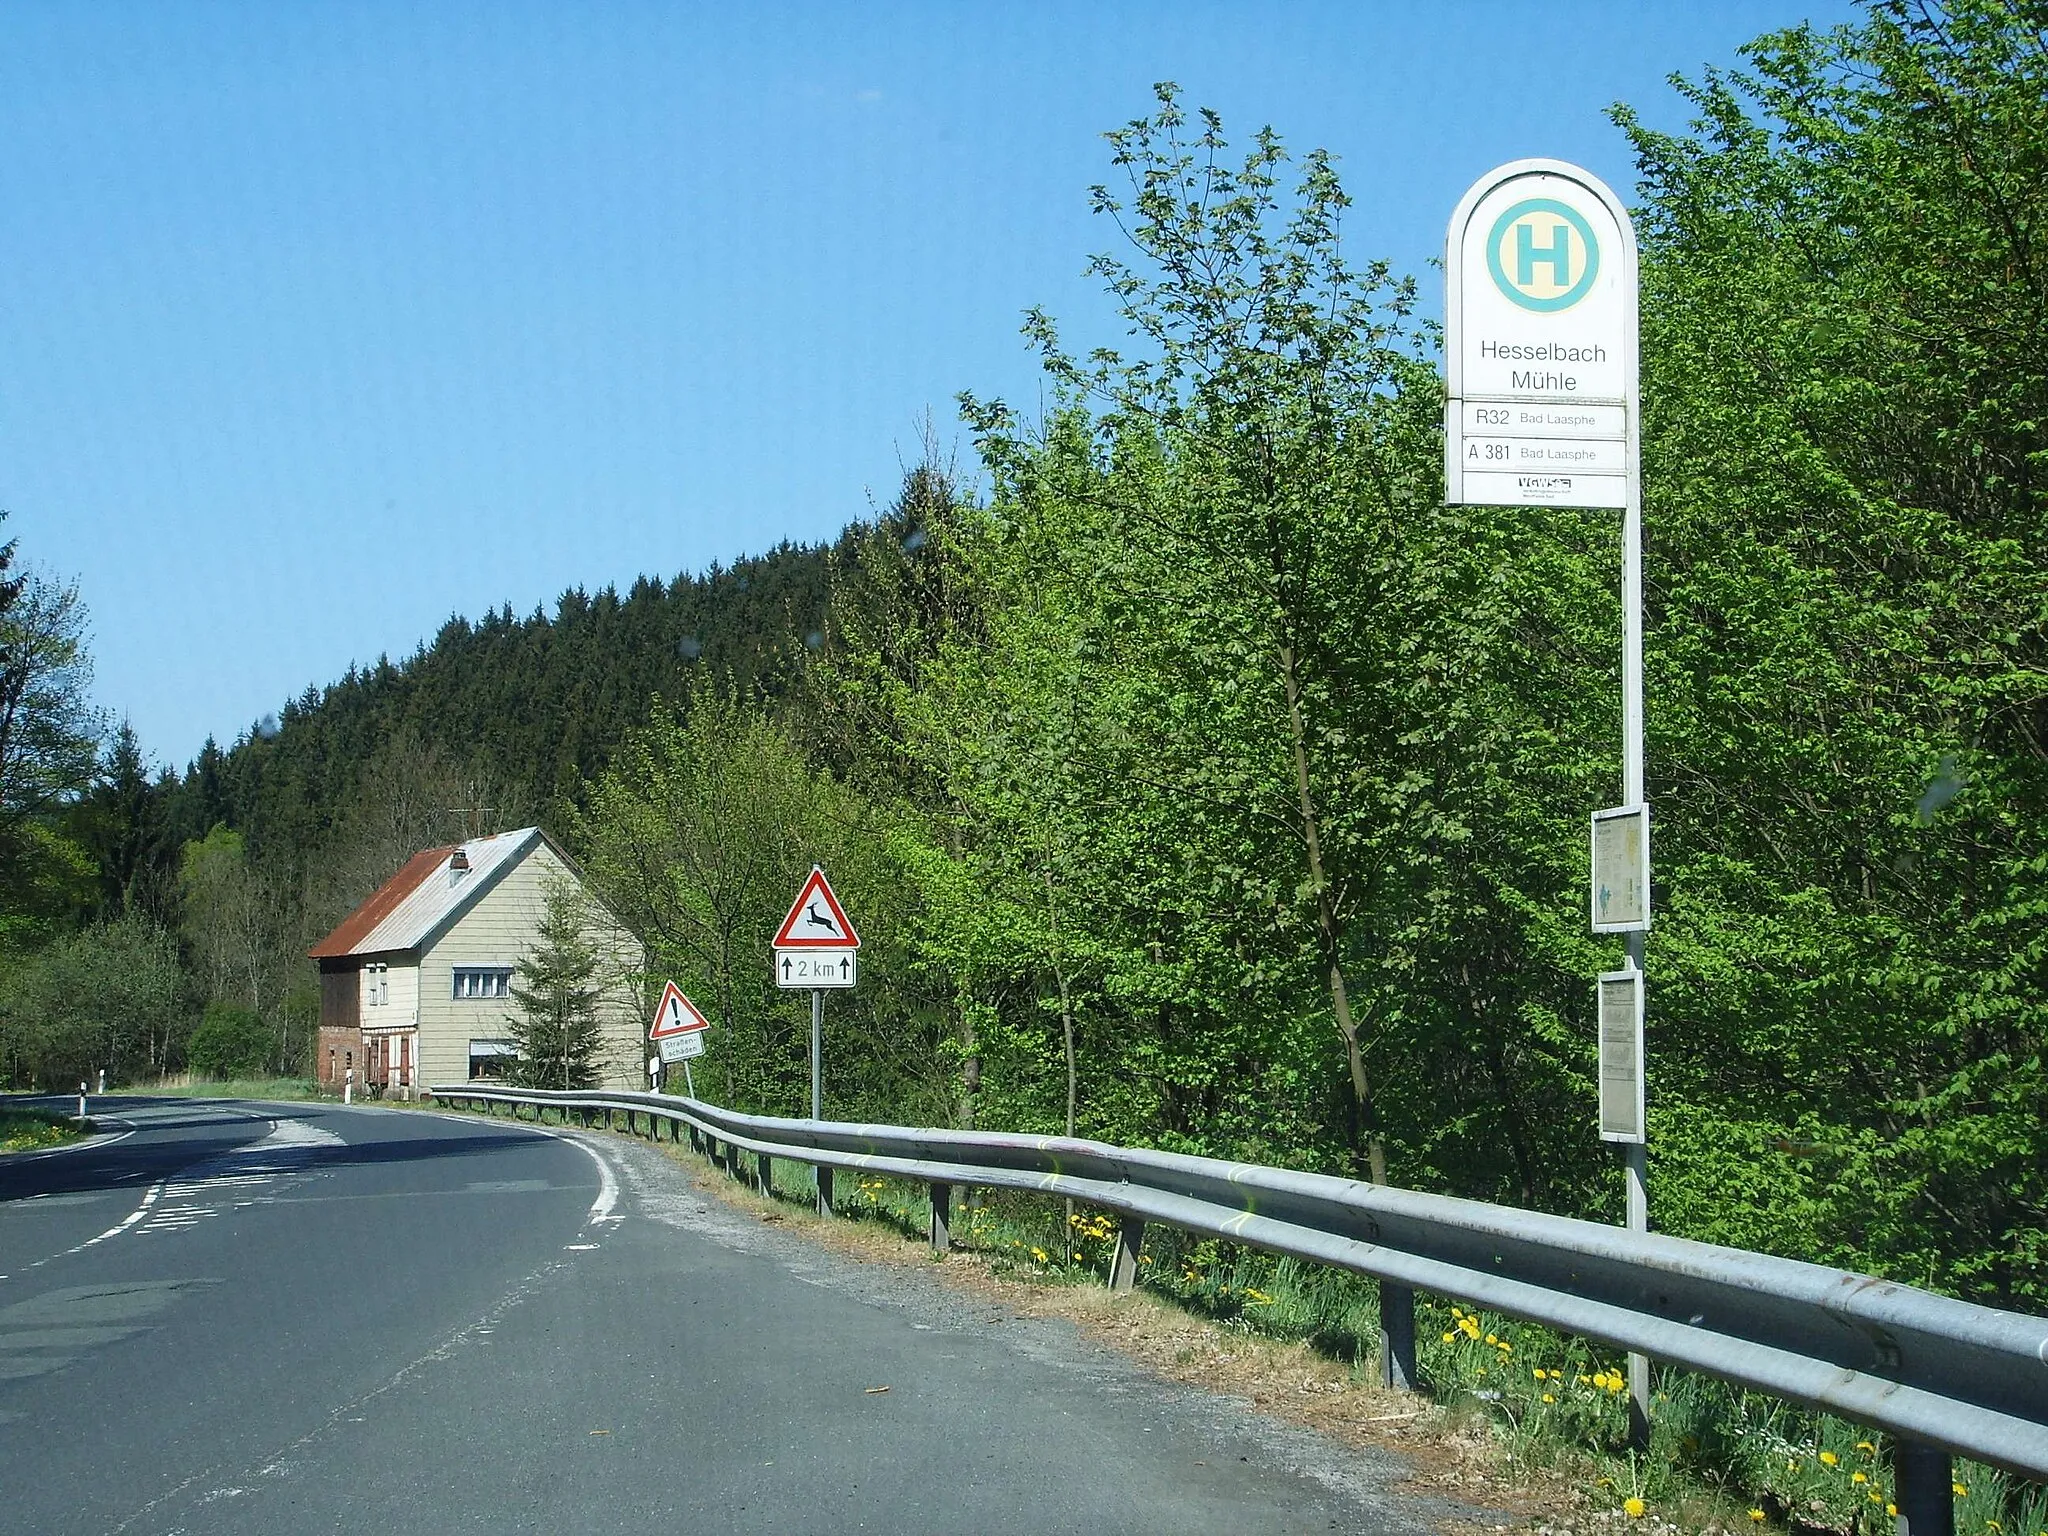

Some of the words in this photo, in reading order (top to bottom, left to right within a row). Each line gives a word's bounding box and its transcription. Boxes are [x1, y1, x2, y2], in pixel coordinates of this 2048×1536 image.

[1517, 224, 1569, 286] H
[1481, 340, 1606, 362] Hesselbach
[1512, 371, 1577, 390] Mühle
[1476, 409, 1510, 425] R32
[1520, 412, 1543, 424] Bad
[1547, 413, 1596, 427] Laasphe
[1468, 444, 1479, 459] A
[1485, 444, 1510, 460] 381
[1520, 448, 1544, 459] Bad
[1547, 448, 1597, 461] Laasphe
[798, 960, 808, 977] 2
[813, 960, 835, 977] km
